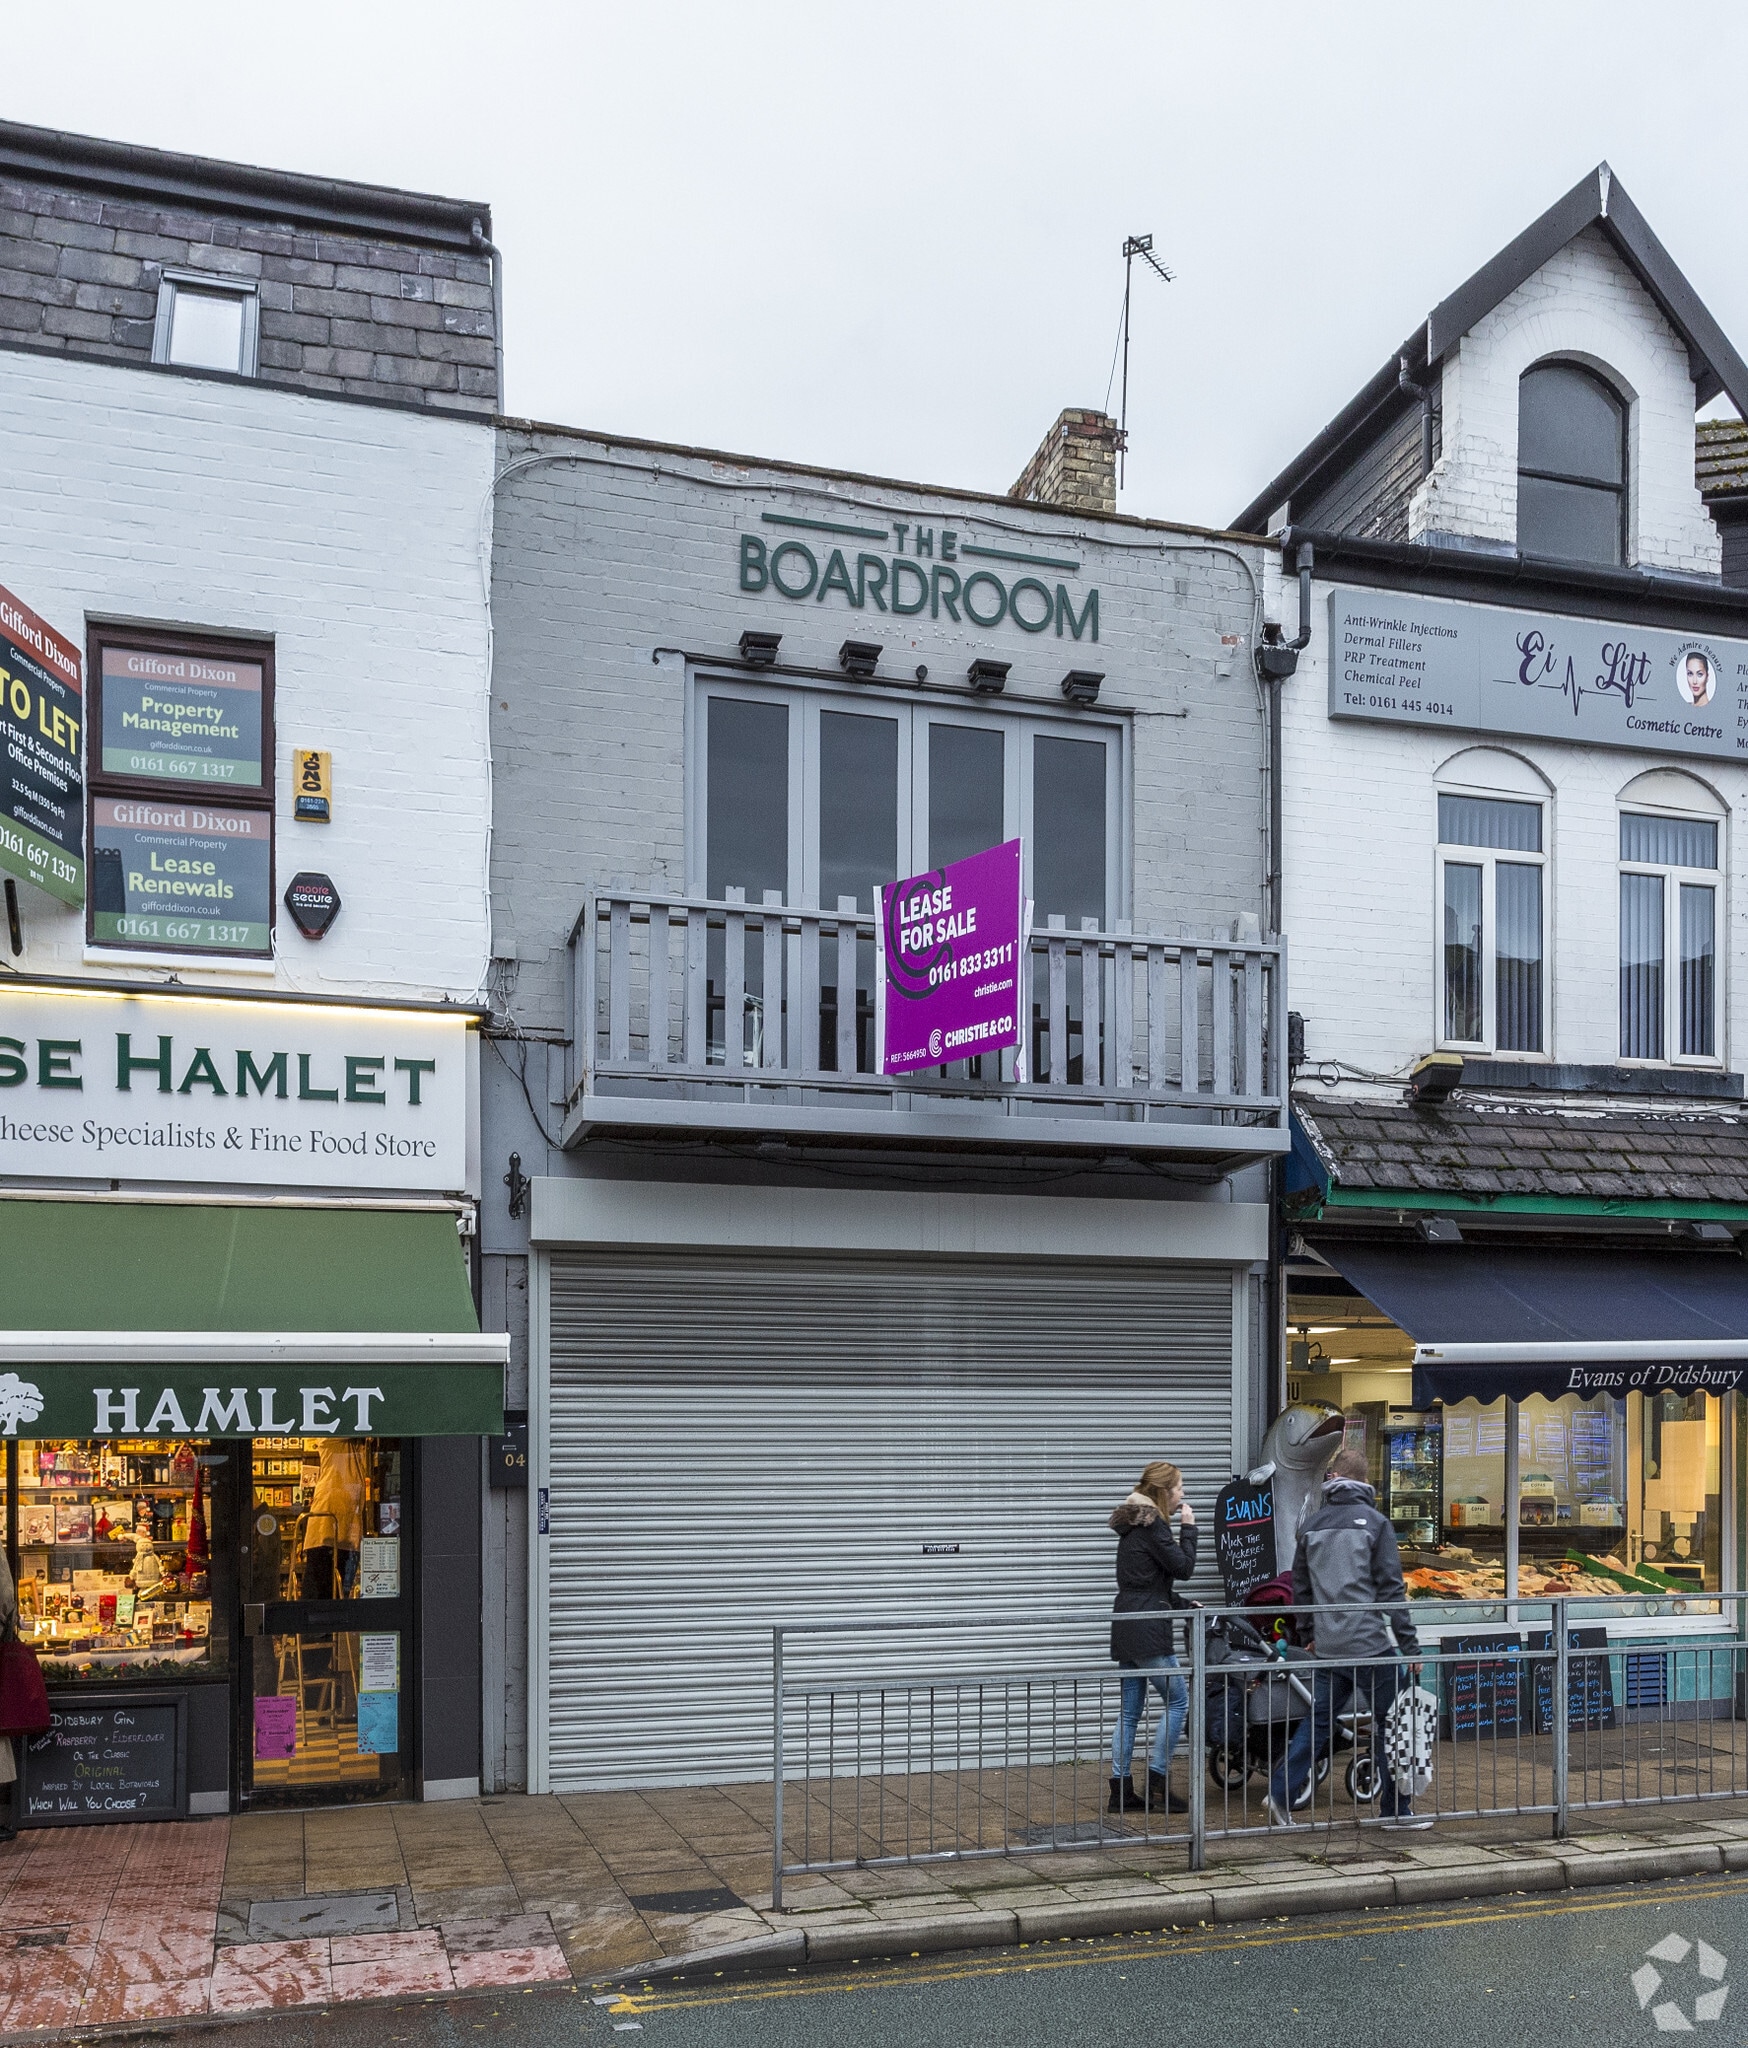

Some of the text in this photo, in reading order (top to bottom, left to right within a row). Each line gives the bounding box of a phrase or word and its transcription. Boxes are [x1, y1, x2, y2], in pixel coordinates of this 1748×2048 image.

[893, 522, 958, 561] THE
[741, 533, 1099, 642] BOARDROOM
[1344, 614, 1458, 639] Anti-Wrinkle Injections
[0, 602, 77, 680] Gifford Dixon
[1344, 632, 1423, 653] Dermal Fillers
[127, 657, 236, 682] Gifford Dixon
[1344, 651, 1426, 671] PRP Treatment
[1703, 645, 1723, 673] Beauty
[10, 647, 66, 698] Commercial Property
[1344, 669, 1421, 689] Chemical Peel
[1595, 642, 1652, 708] Lift
[144, 682, 218, 698] Commercial Property
[142, 696, 224, 724] Property
[1343, 692, 1453, 715] Tel: 0161 445 4014
[39, 695, 80, 756] LET
[122, 711, 239, 738] Management
[1626, 715, 1723, 739] Cosmetic Centre
[8, 722, 28, 748] First
[28, 736, 35, 752] &
[35, 741, 64, 773] Second
[150, 741, 212, 754] gifforddixon.co.uk
[8, 743, 68, 793] Office Premises
[130, 756, 235, 778] 0161 667 1317
[13, 805, 63, 841] gifforddixon.co.uk
[113, 805, 251, 833] Gifford Dixon
[134, 833, 227, 851] Commercial Property
[27, 843, 49, 868] 667
[52, 855, 77, 884] 1317
[151, 852, 216, 876] Lease
[128, 872, 234, 899] Renewals
[292, 893, 333, 903] secure
[295, 885, 329, 895] moore
[141, 901, 221, 915] gifforddixon.co.uk
[900, 886, 952, 924] LEASE
[116, 918, 250, 943] 0161 667 1317
[900, 907, 976, 954] FOR SALE
[929, 942, 1012, 986] 0161 833 3311
[974, 979, 1013, 998] christie.com
[115, 1033, 436, 1105] HAMLET
[82, 1120, 216, 1151] Specialists
[223, 1127, 243, 1150] &
[249, 1127, 302, 1152] Fine
[309, 1131, 368, 1155] Food
[375, 1133, 436, 1157] Store
[1566, 1365, 1743, 1389] Evans of Didsbury
[93, 1386, 385, 1434] HAMLET
[1225, 1492, 1272, 1521] EVANS
[50, 1711, 135, 1726] DIDSBURY GIN
[55, 1732, 98, 1747] RASPBERRY
[74, 1763, 126, 1778] ORIGINAL
[29, 1797, 53, 1815] WHICH
[58, 1797, 79, 1811] WILL
[85, 1796, 103, 1809] YOU
